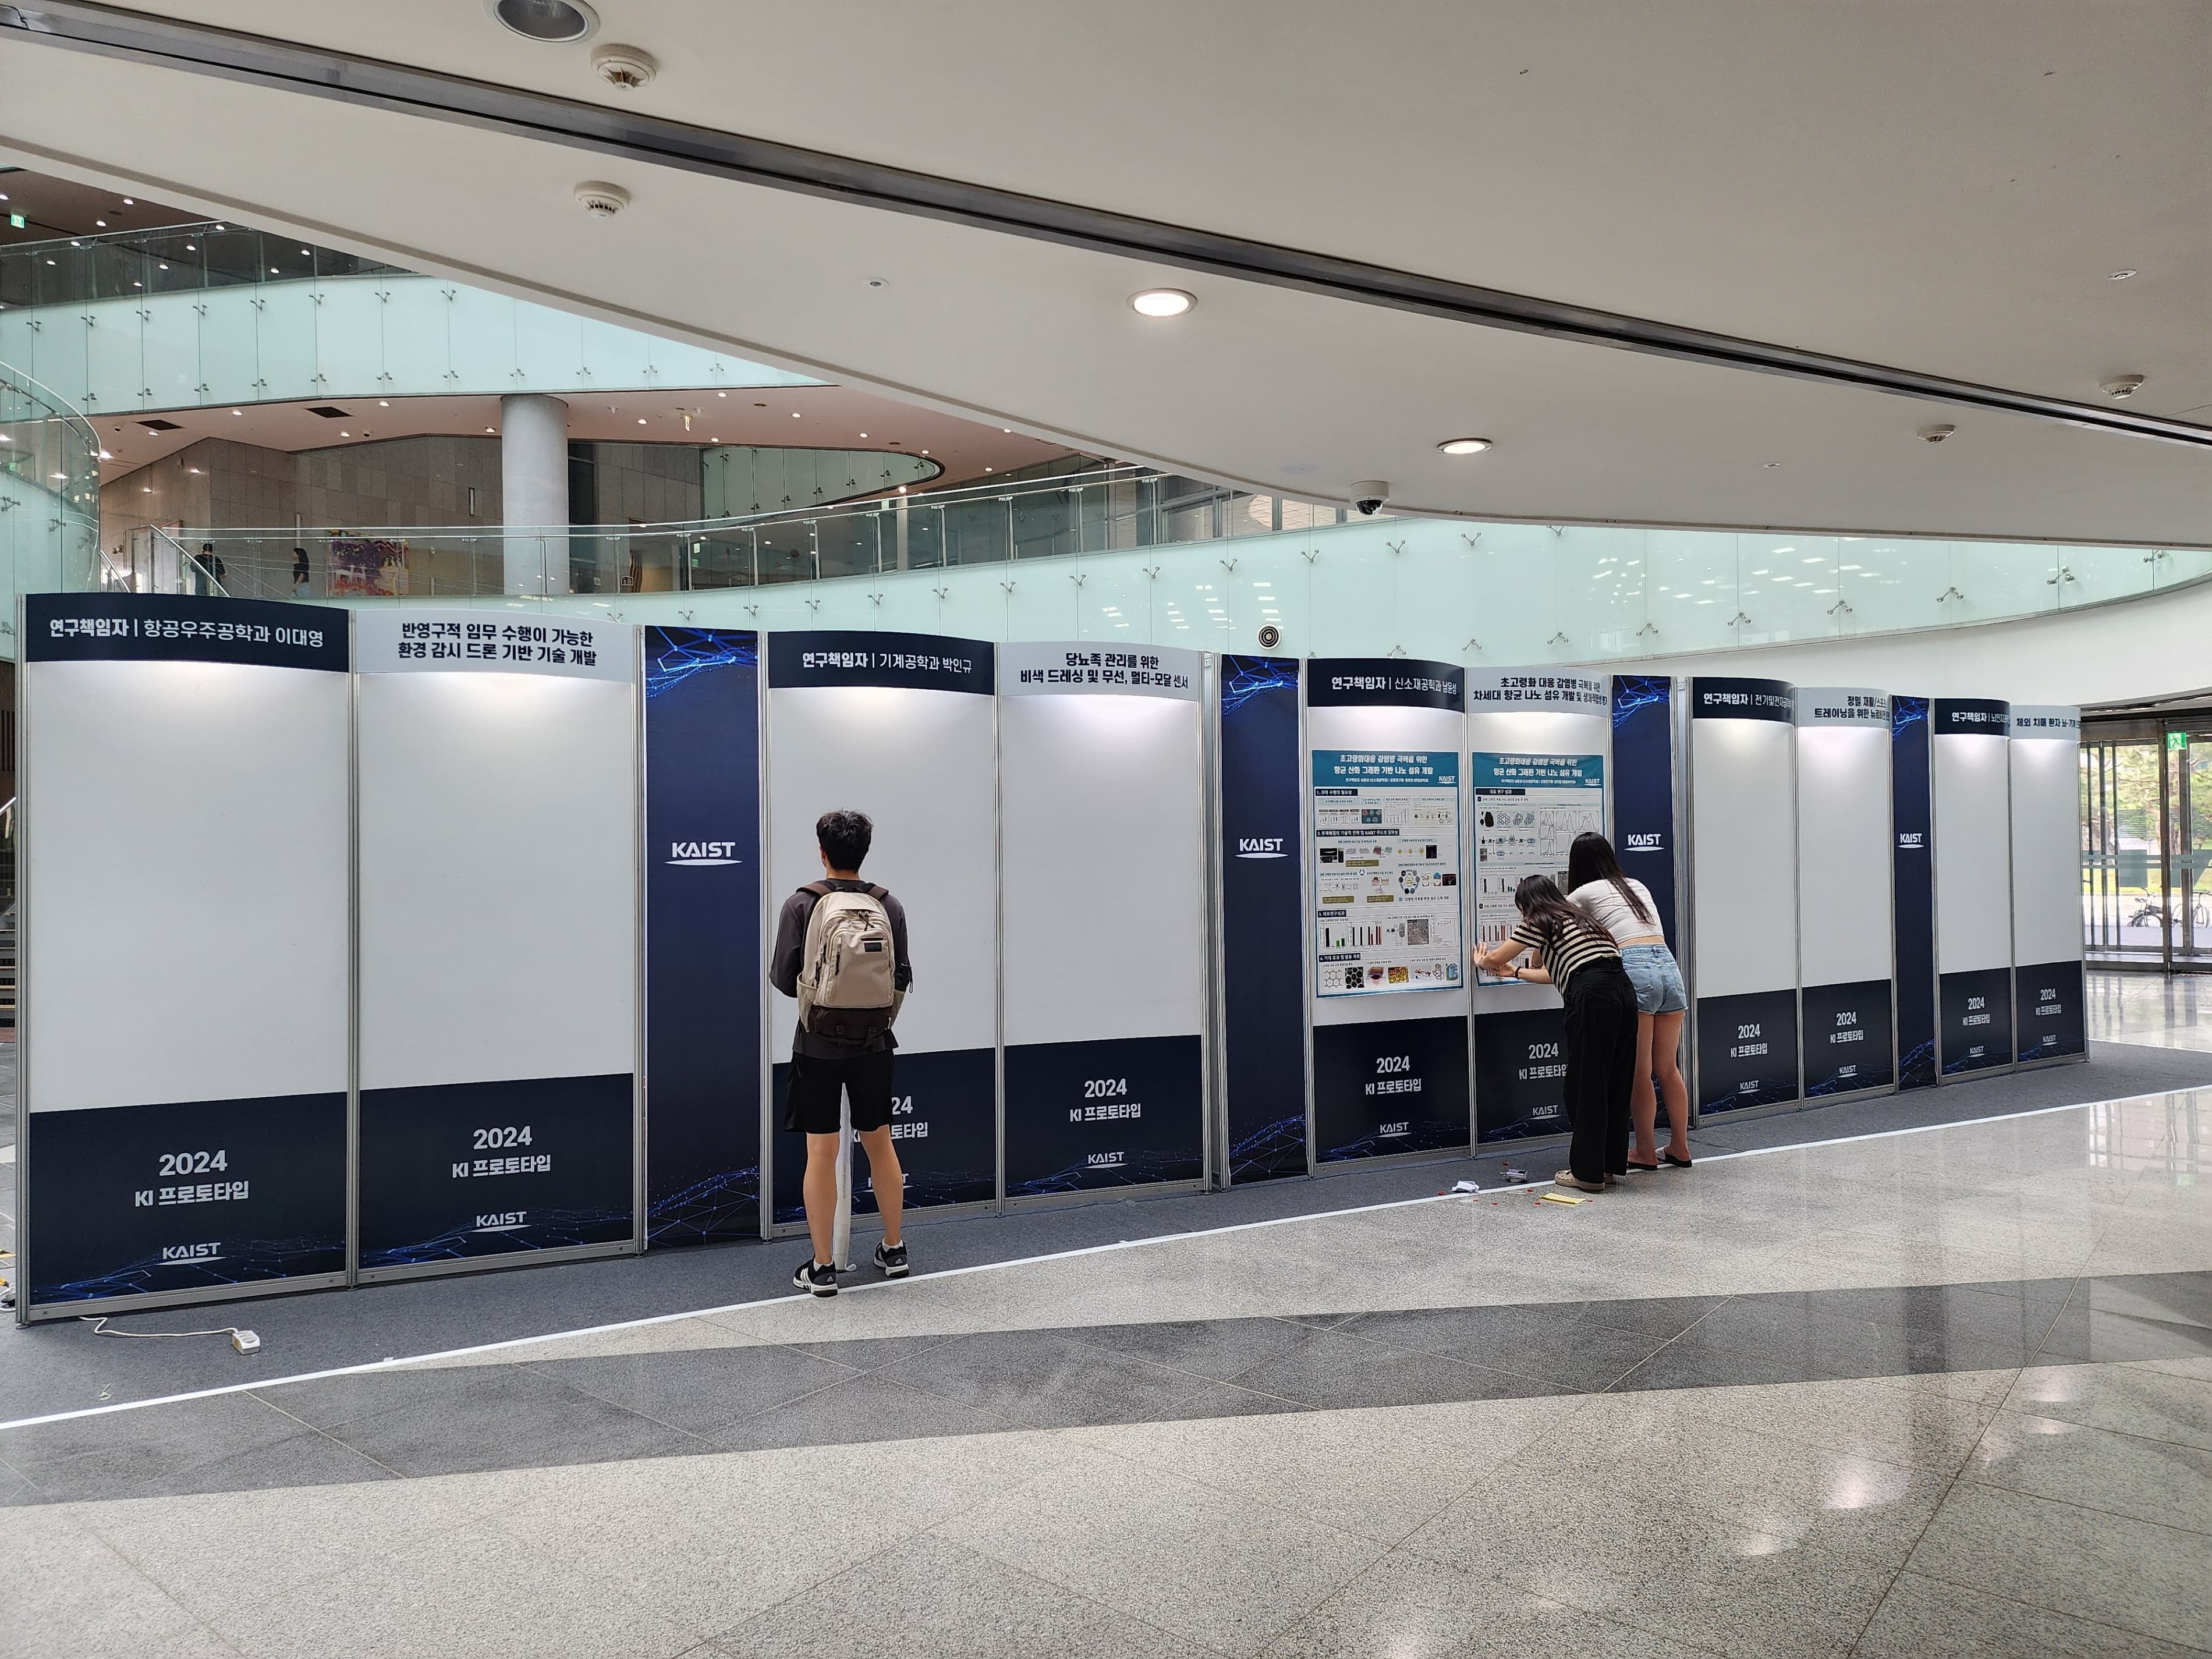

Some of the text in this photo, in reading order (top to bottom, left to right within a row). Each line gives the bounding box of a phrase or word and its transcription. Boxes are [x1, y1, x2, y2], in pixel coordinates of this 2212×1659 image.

[49, 618, 129, 637] 연구책임자
[144, 619, 270, 643] 항공우주공학과
[275, 627, 324, 648] 이대영
[402, 623, 593, 647] 반영구적 임무 수행이 가능한
[398, 641, 597, 667] 환경 감시 드론 기반 기술 개발
[1066, 653, 1159, 669] 당뇨족 관리를 위한
[802, 652, 869, 668] 연구책임자
[880, 653, 940, 671] 기계공학과
[942, 657, 972, 673] 박인규
[1020, 669, 1189, 689] 비색 드레싱 및 무선, 멀티-모달 센서
[1331, 676, 1386, 690] 연구책임자
[1394, 677, 1442, 693] 신소재공학과
[1442, 681, 1457, 695] 남윤성
[1501, 677, 1537, 688] 초고령화
[1539, 678, 1555, 688] 대응
[1579, 679, 1593, 690] 극복을
[1473, 690, 1501, 701] 차세대
[1504, 690, 1522, 700] 항균
[1525, 690, 1542, 700] 나노
[1544, 690, 1559, 701] 섬유
[1561, 690, 1575, 701] 개발
[1576, 692, 1582, 703] 및
[1703, 693, 1749, 705] 연구책임자
[1847, 696, 1861, 707] 정밀
[1814, 708, 1855, 718] 트레이닝을
[1857, 708, 1869, 719] 위한
[1952, 712, 1987, 722] 연구책임자
[2048, 718, 2061, 727] 환자
[1239, 838, 1283, 851] KAIST
[1628, 834, 1661, 846] KAIST
[1899, 833, 1922, 843] KAIST
[671, 842, 736, 858] KAIST
[2040, 988, 2056, 1001] 2024
[1968, 997, 1985, 1010] 2024
[1837, 1011, 1856, 1026] 2024
[1738, 1023, 1760, 1039] 2024
[1830, 1029, 1863, 1044] KI 프로토타입
[2043, 1034, 2056, 1043] KAIST
[1528, 1043, 1559, 1059] 2024
[1731, 1043, 1768, 1058] KI 프로토타입
[1970, 1045, 1984, 1054] KAIST
[1376, 1055, 1410, 1073] 2024
[1839, 1065, 1856, 1075] KAIST
[1519, 1068, 1527, 1080] KI
[1084, 1078, 1128, 1098] 2024
[1365, 1078, 1422, 1096] KI 프로토타입
[1740, 1080, 1759, 1090] KAIST
[891, 1096, 913, 1115] 24
[1069, 1103, 1141, 1122] KI 프로토타입
[1533, 1105, 1558, 1116] KAIST
[891, 1122, 928, 1139] 토타입
[1380, 1122, 1409, 1133] KAIST
[473, 1126, 533, 1150] 2024
[159, 1150, 228, 1176] 2024
[1088, 1151, 1125, 1164] KAIST
[452, 1154, 551, 1178] KI 프로토타입
[135, 1181, 249, 1207] KI 프로토타입
[476, 1211, 527, 1227] KAIST
[162, 1242, 221, 1260] KAIST
